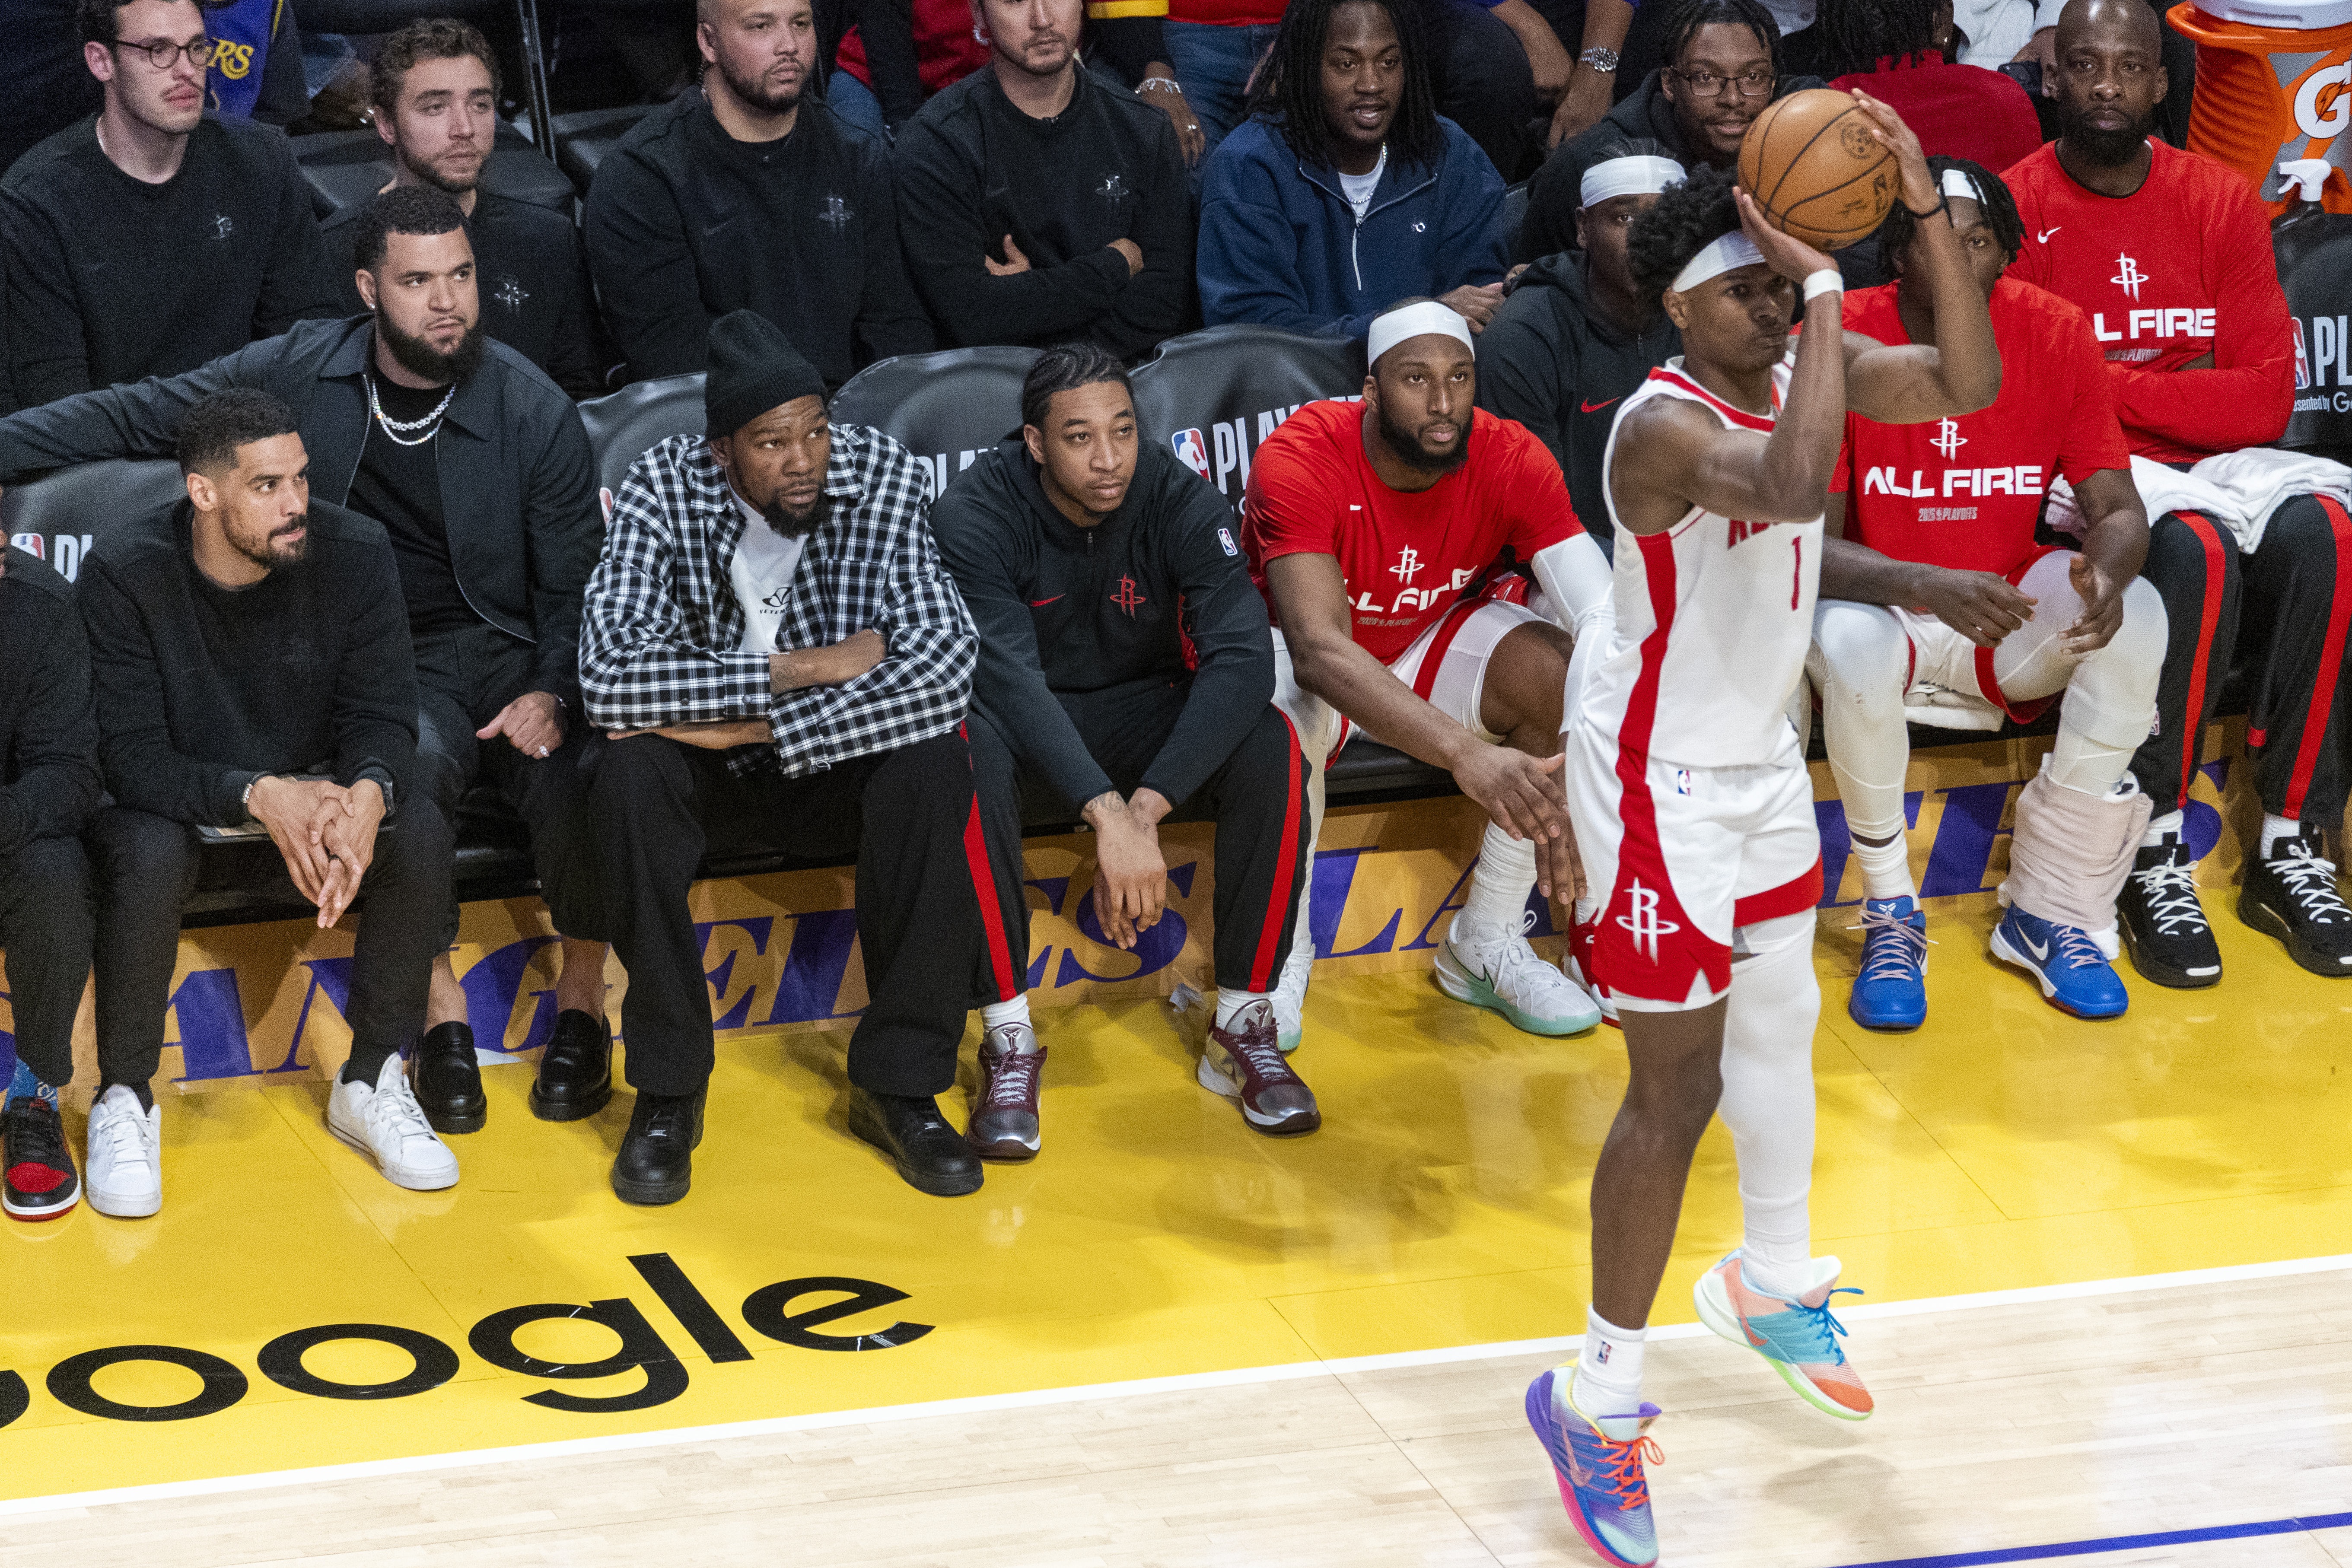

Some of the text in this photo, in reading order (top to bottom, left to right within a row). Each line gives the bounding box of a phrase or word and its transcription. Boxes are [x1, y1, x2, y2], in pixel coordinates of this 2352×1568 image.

[2129, 308, 2216, 339] FIRE
[1864, 466, 2043, 498] ALL FIRE
[1792, 536, 1801, 611] 1
[0, 1252, 936, 1433] oogle
